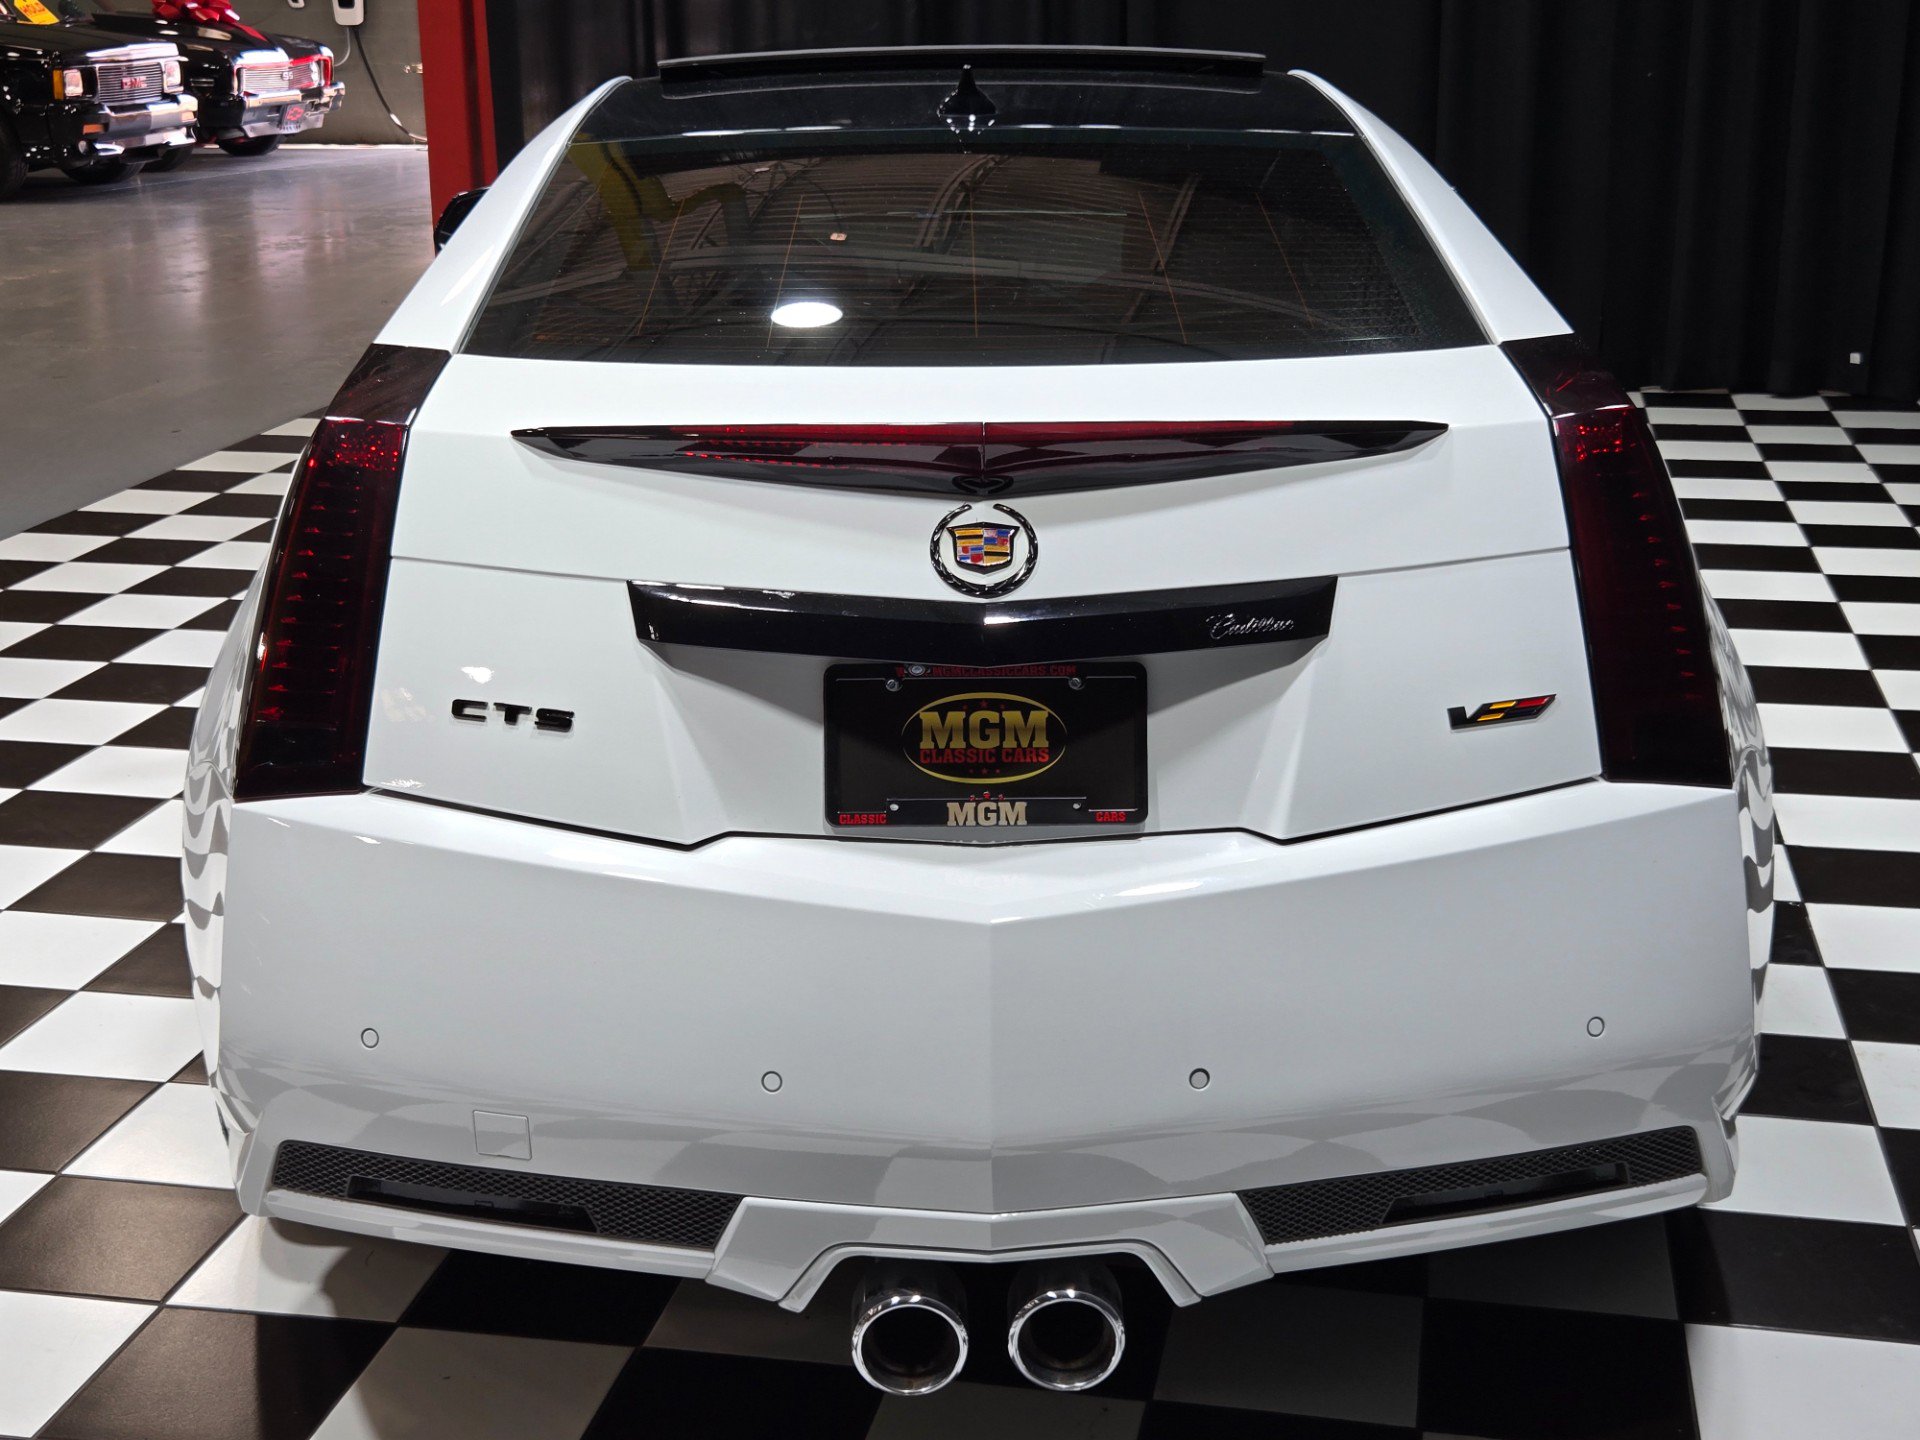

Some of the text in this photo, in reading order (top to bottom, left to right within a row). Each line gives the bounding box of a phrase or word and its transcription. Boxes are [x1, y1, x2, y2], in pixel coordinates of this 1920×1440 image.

[282, 71, 294, 80] SS
[1206, 613, 1294, 639] Cadillac
[451, 699, 575, 733] CTS
[919, 710, 1050, 749] MGM
[919, 748, 1050, 764] CLASSIC CARS
[839, 814, 887, 825] CLASSIC
[947, 802, 1028, 826] MGM
[1096, 811, 1127, 822] CARS
